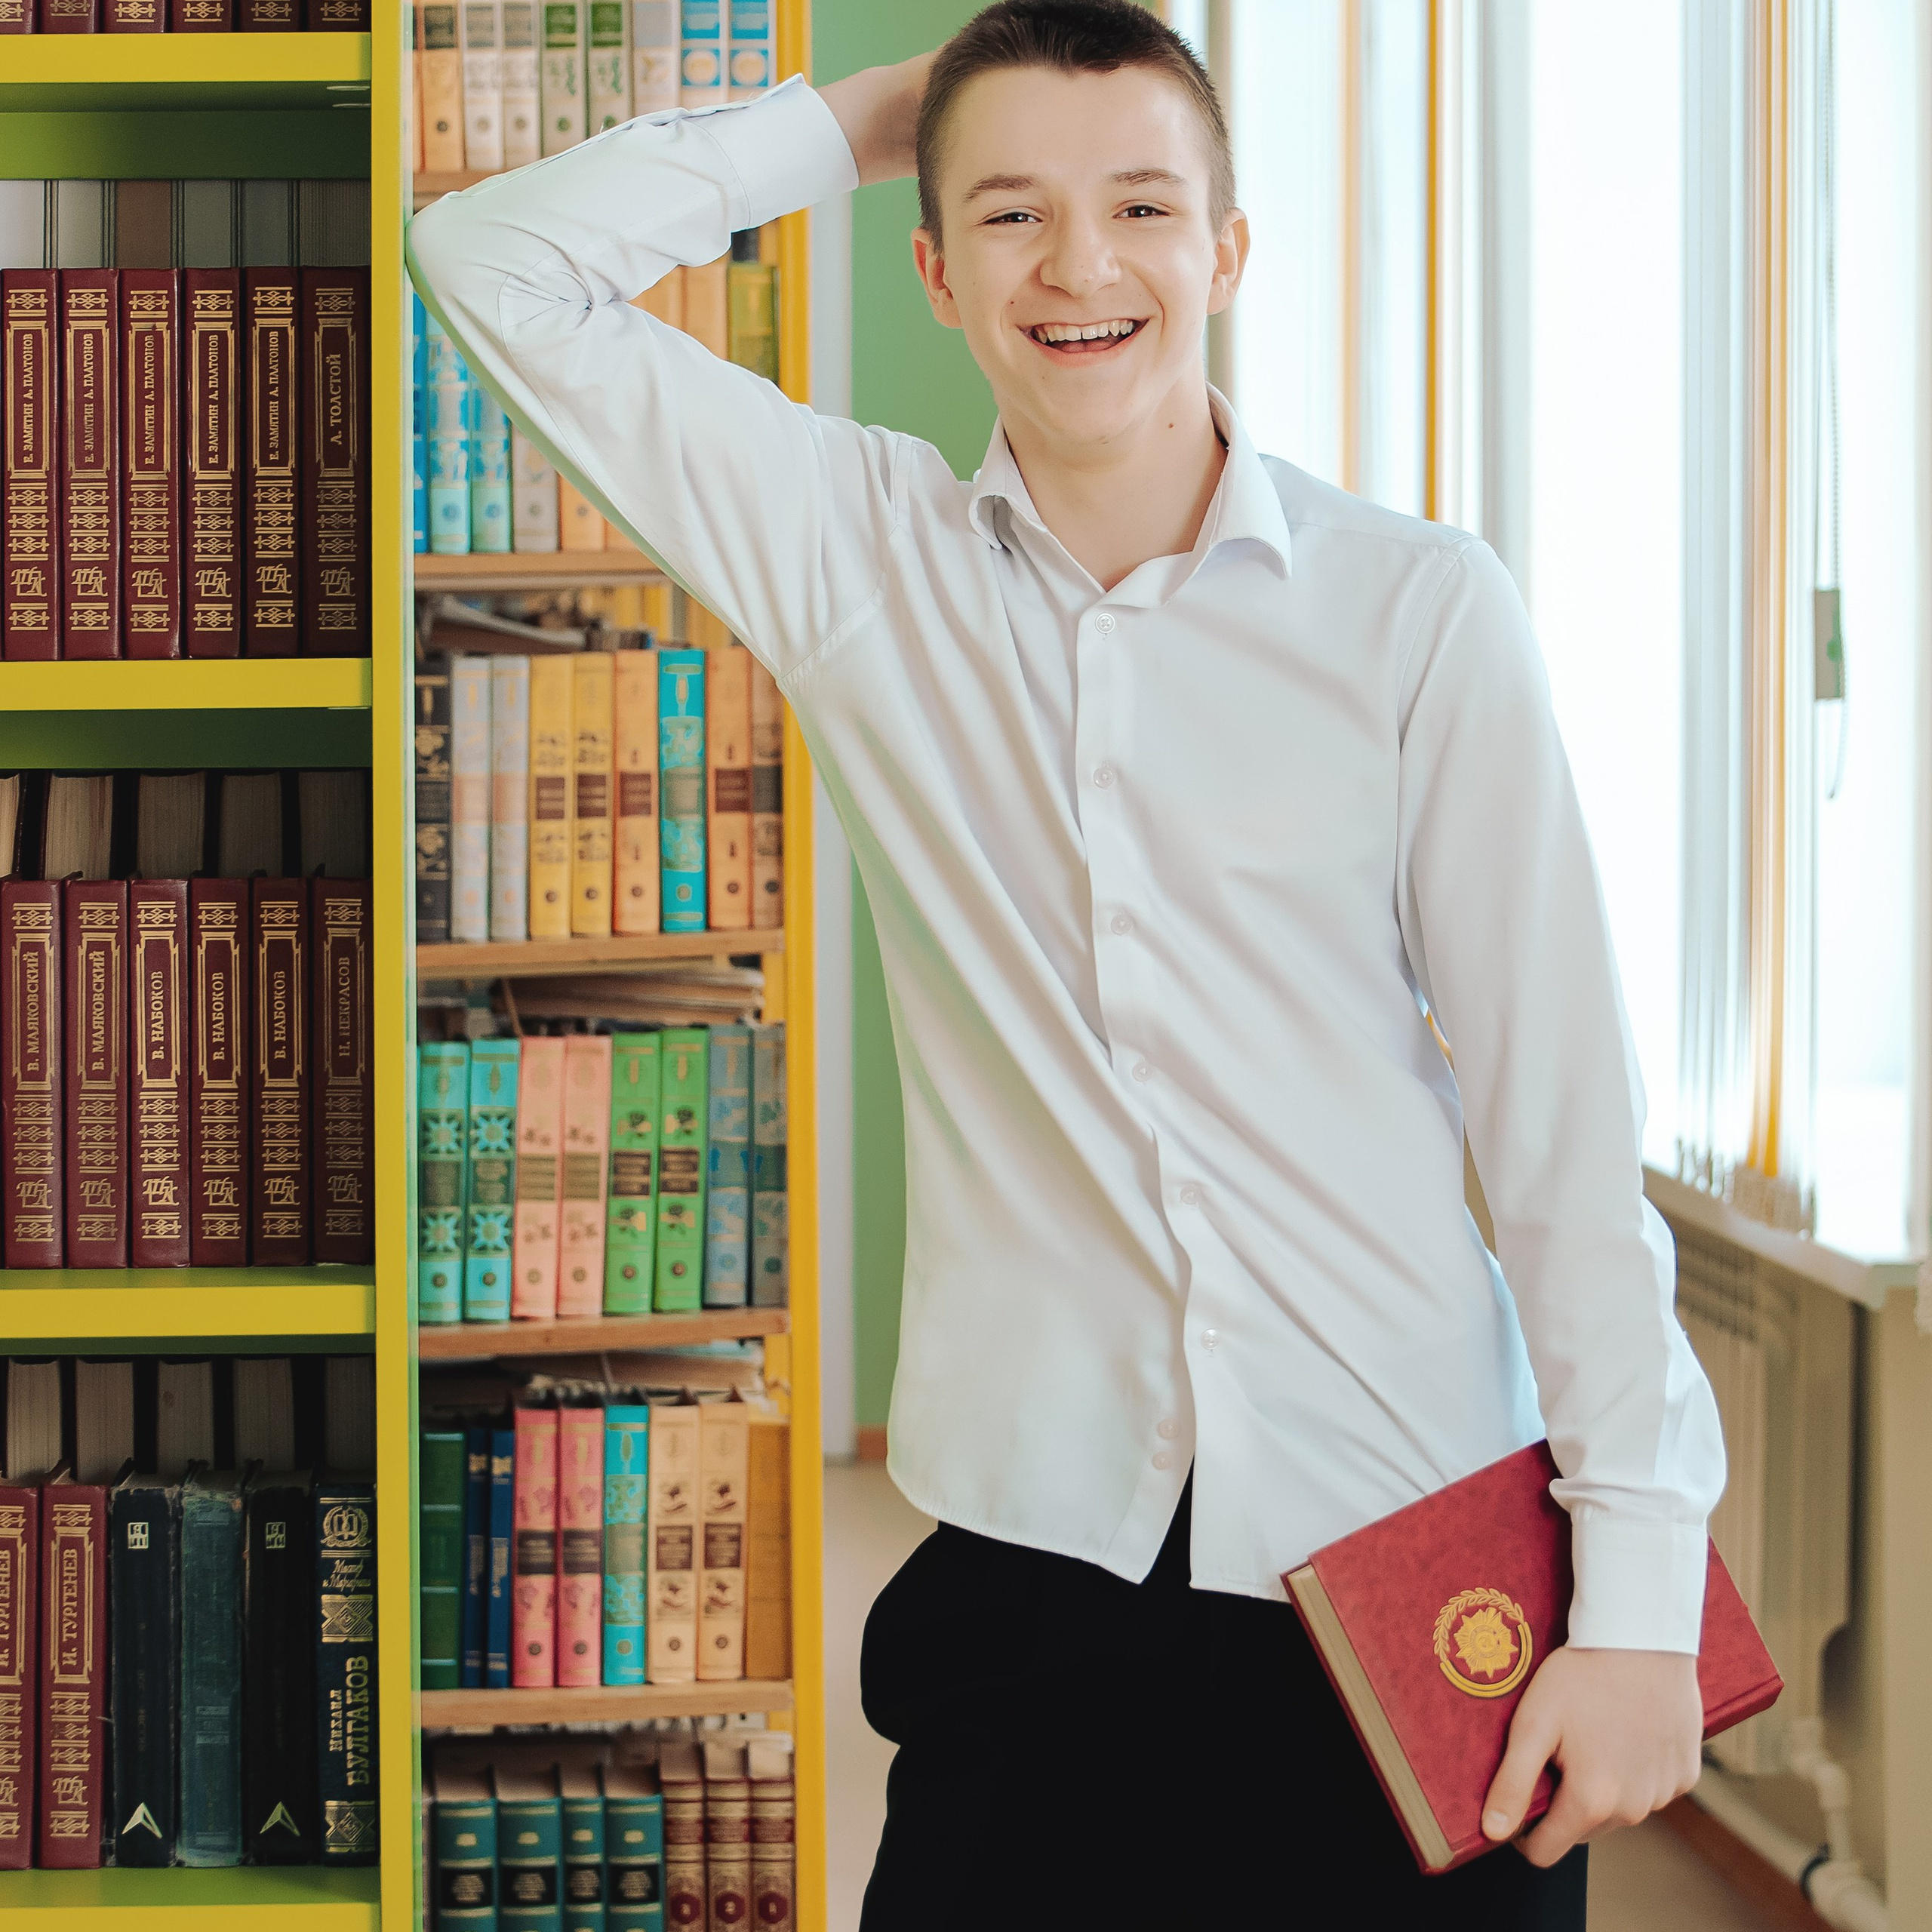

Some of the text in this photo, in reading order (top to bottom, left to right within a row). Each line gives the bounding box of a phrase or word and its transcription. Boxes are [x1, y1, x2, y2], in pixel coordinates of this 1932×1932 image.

[23, 333, 34, 388] ПЛАТОНОВ
[82, 333, 94, 387] ПЛАТОНОВ
[144, 334, 155, 389] ПЛАТОНОВ
[208, 334, 219, 389] ПЛАТОНОВ
[269, 331, 279, 386] ПЛАТОНОВ
[325, 353, 342, 428] ТОЛСТОЙ
[23, 402, 34, 451] ЗАМЯТИН
[144, 404, 155, 453] ЗАМЯТИН
[208, 404, 219, 453] ЗАМЯТИН
[269, 400, 279, 449] ЗАМЯТИН
[22, 951, 40, 1054] МАЯКОВСКИЙ
[88, 950, 105, 1054] МАЯКОВСКИЙ
[150, 971, 165, 1043] НАБОКОВ
[211, 972, 225, 1043] НАБОКОВ
[273, 971, 286, 1042] НАБОКОВ
[338, 956, 350, 1036] НЕКРАСОВ
[62, 1548, 78, 1643] ТУРГЕНЕВ
[345, 1655, 369, 1786] БУЛГАКОВ
